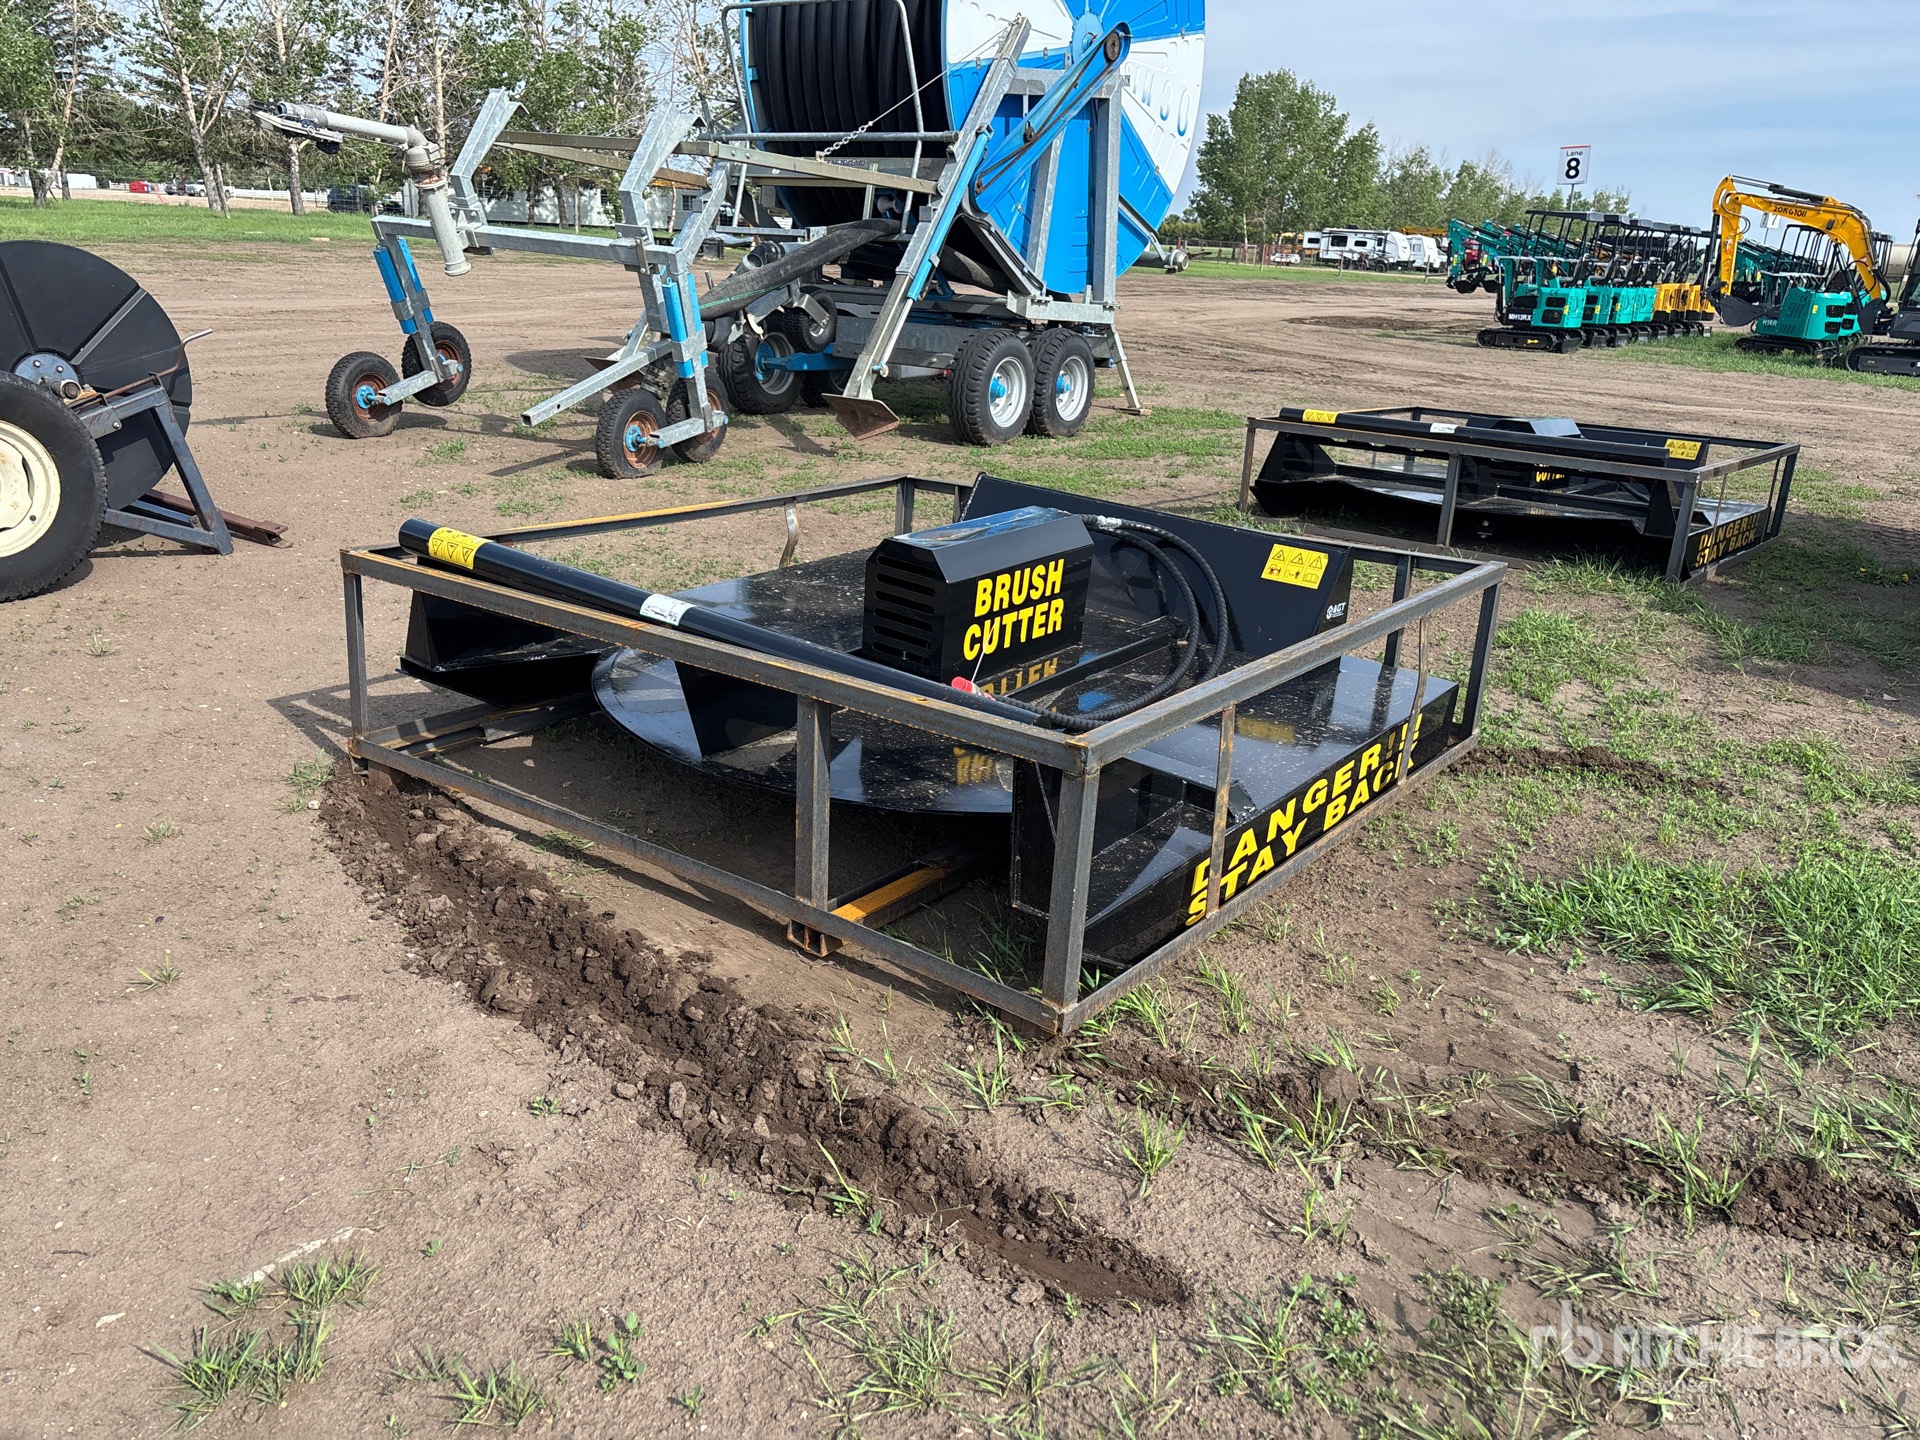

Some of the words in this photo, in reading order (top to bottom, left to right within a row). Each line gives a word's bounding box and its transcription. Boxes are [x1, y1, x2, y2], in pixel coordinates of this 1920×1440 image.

[1565, 157, 1581, 180] 8
[1728, 528, 1756, 552] BACK
[974, 559, 1065, 617] BRUSH
[963, 598, 1065, 661] CUTTER
